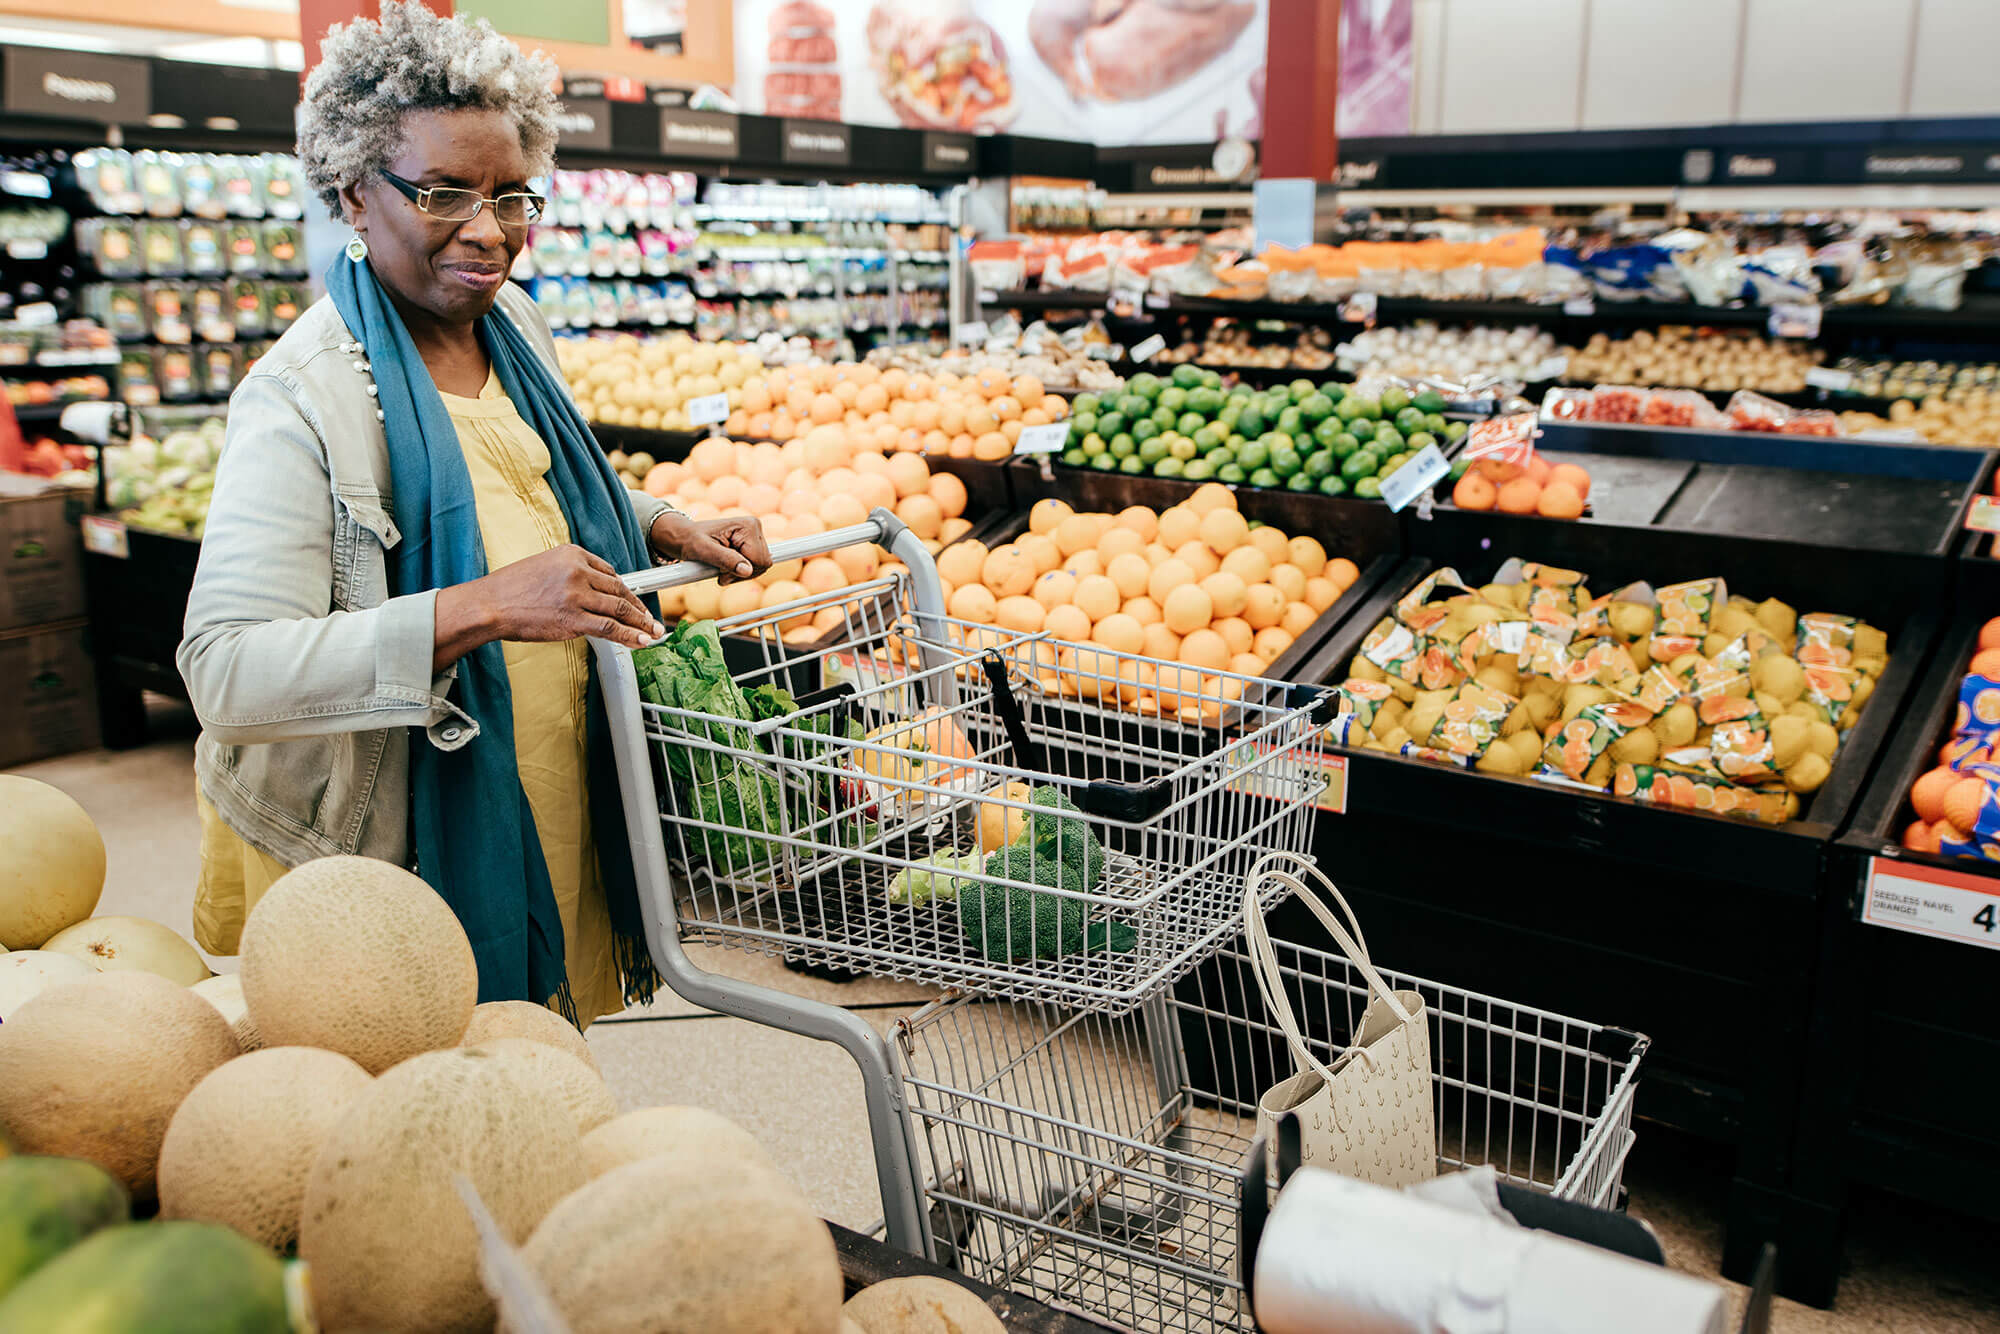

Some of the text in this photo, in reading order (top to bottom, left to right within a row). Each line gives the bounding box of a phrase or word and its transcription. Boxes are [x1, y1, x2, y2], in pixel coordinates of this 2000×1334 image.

[1872, 900, 1917, 915] ORANGES
[1874, 889, 1955, 915] SEEDLESS NAVEL
